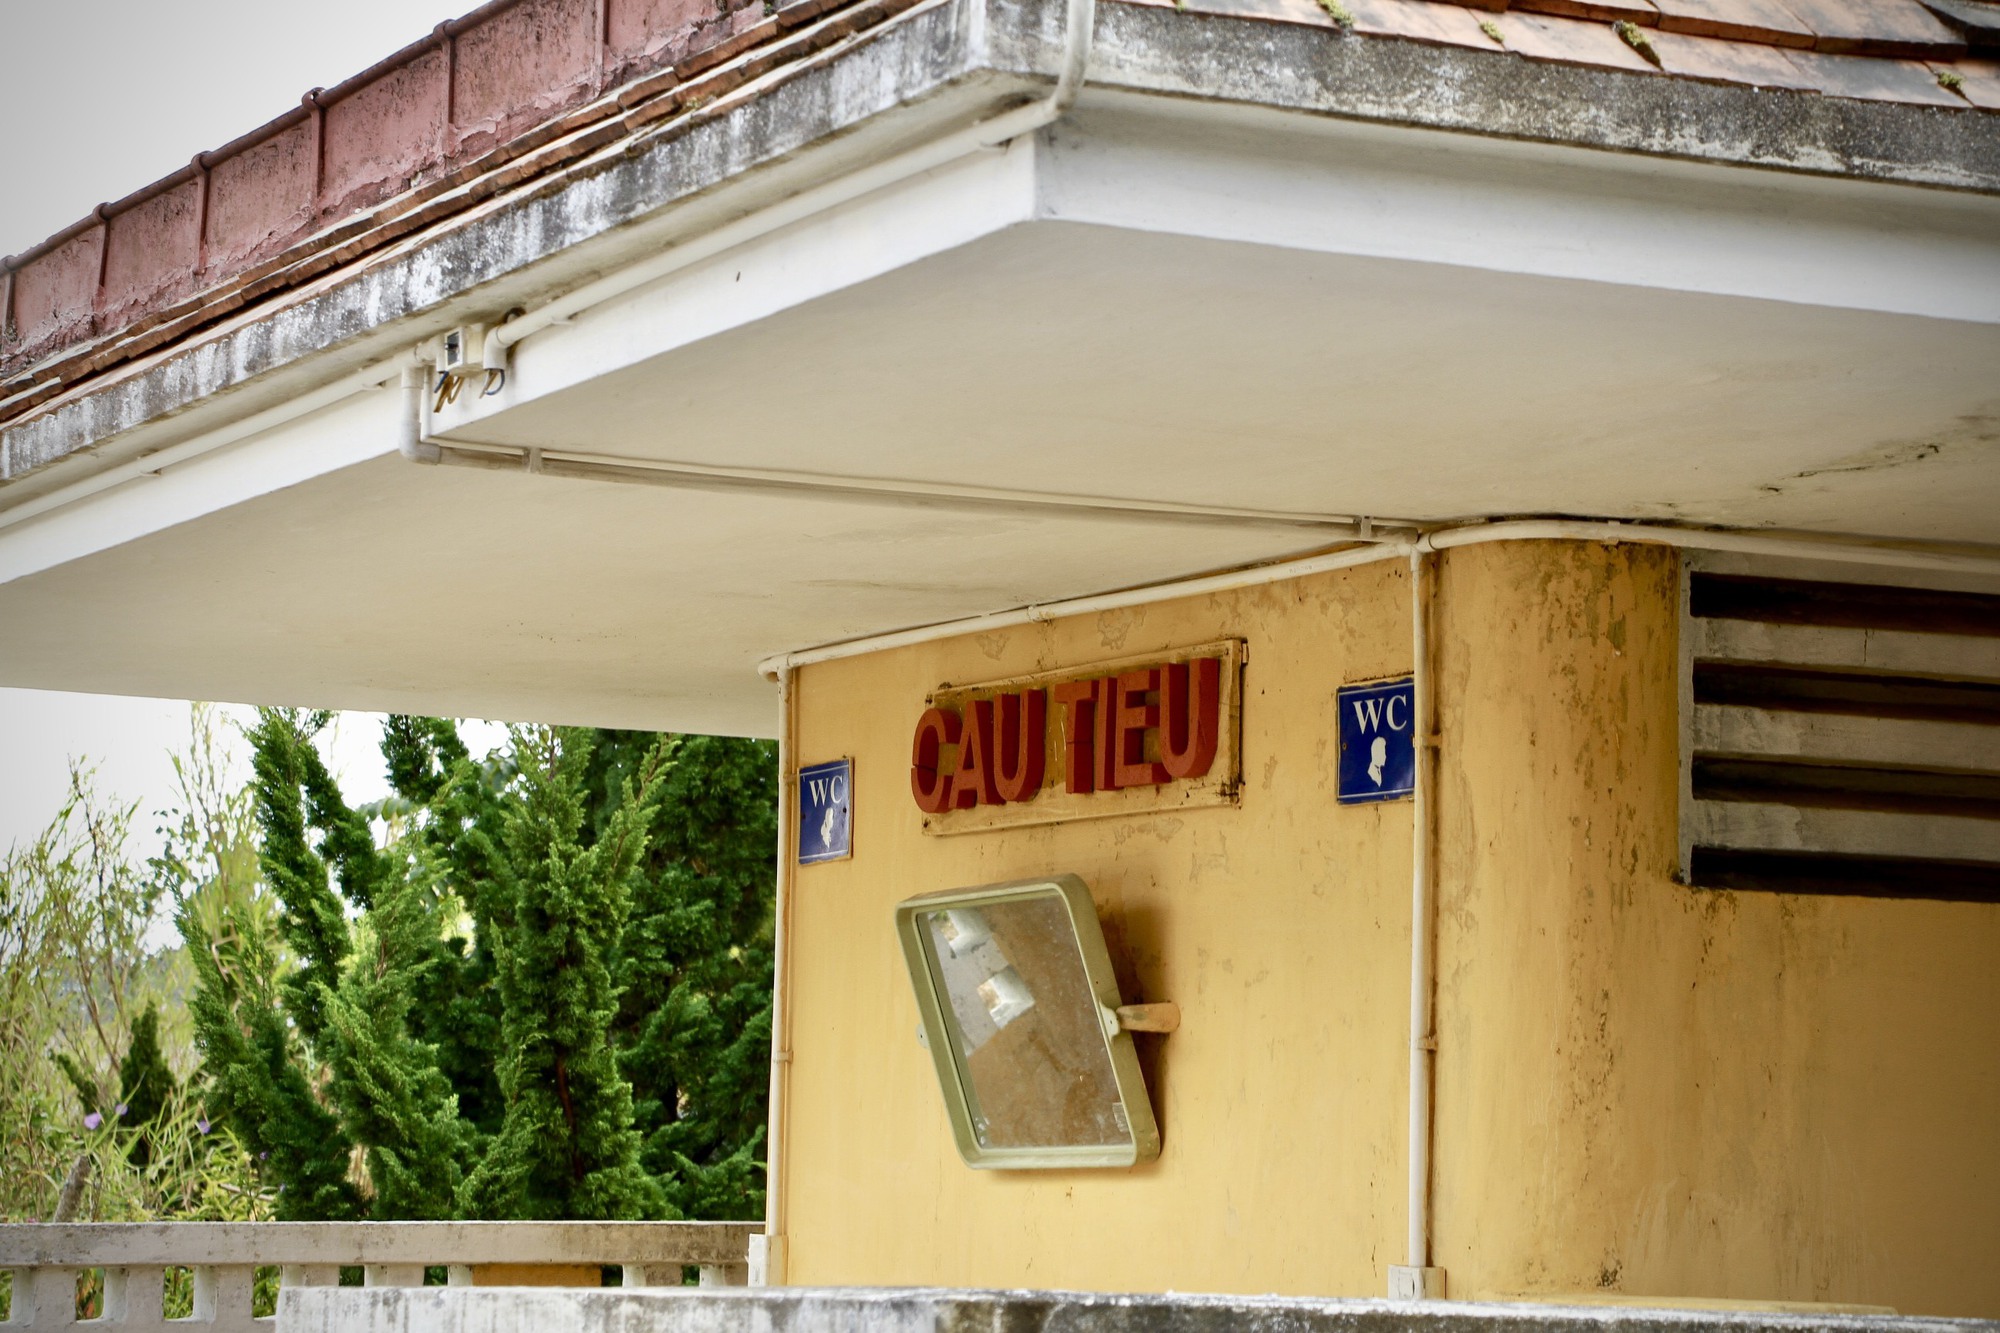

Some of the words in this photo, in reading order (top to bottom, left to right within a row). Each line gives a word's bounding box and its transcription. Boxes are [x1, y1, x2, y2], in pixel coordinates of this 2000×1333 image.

[1352, 694, 1407, 735] WC
[911, 688, 1047, 814] CAU
[1053, 657, 1220, 794] TIEU
[809, 775, 843, 807] WC
